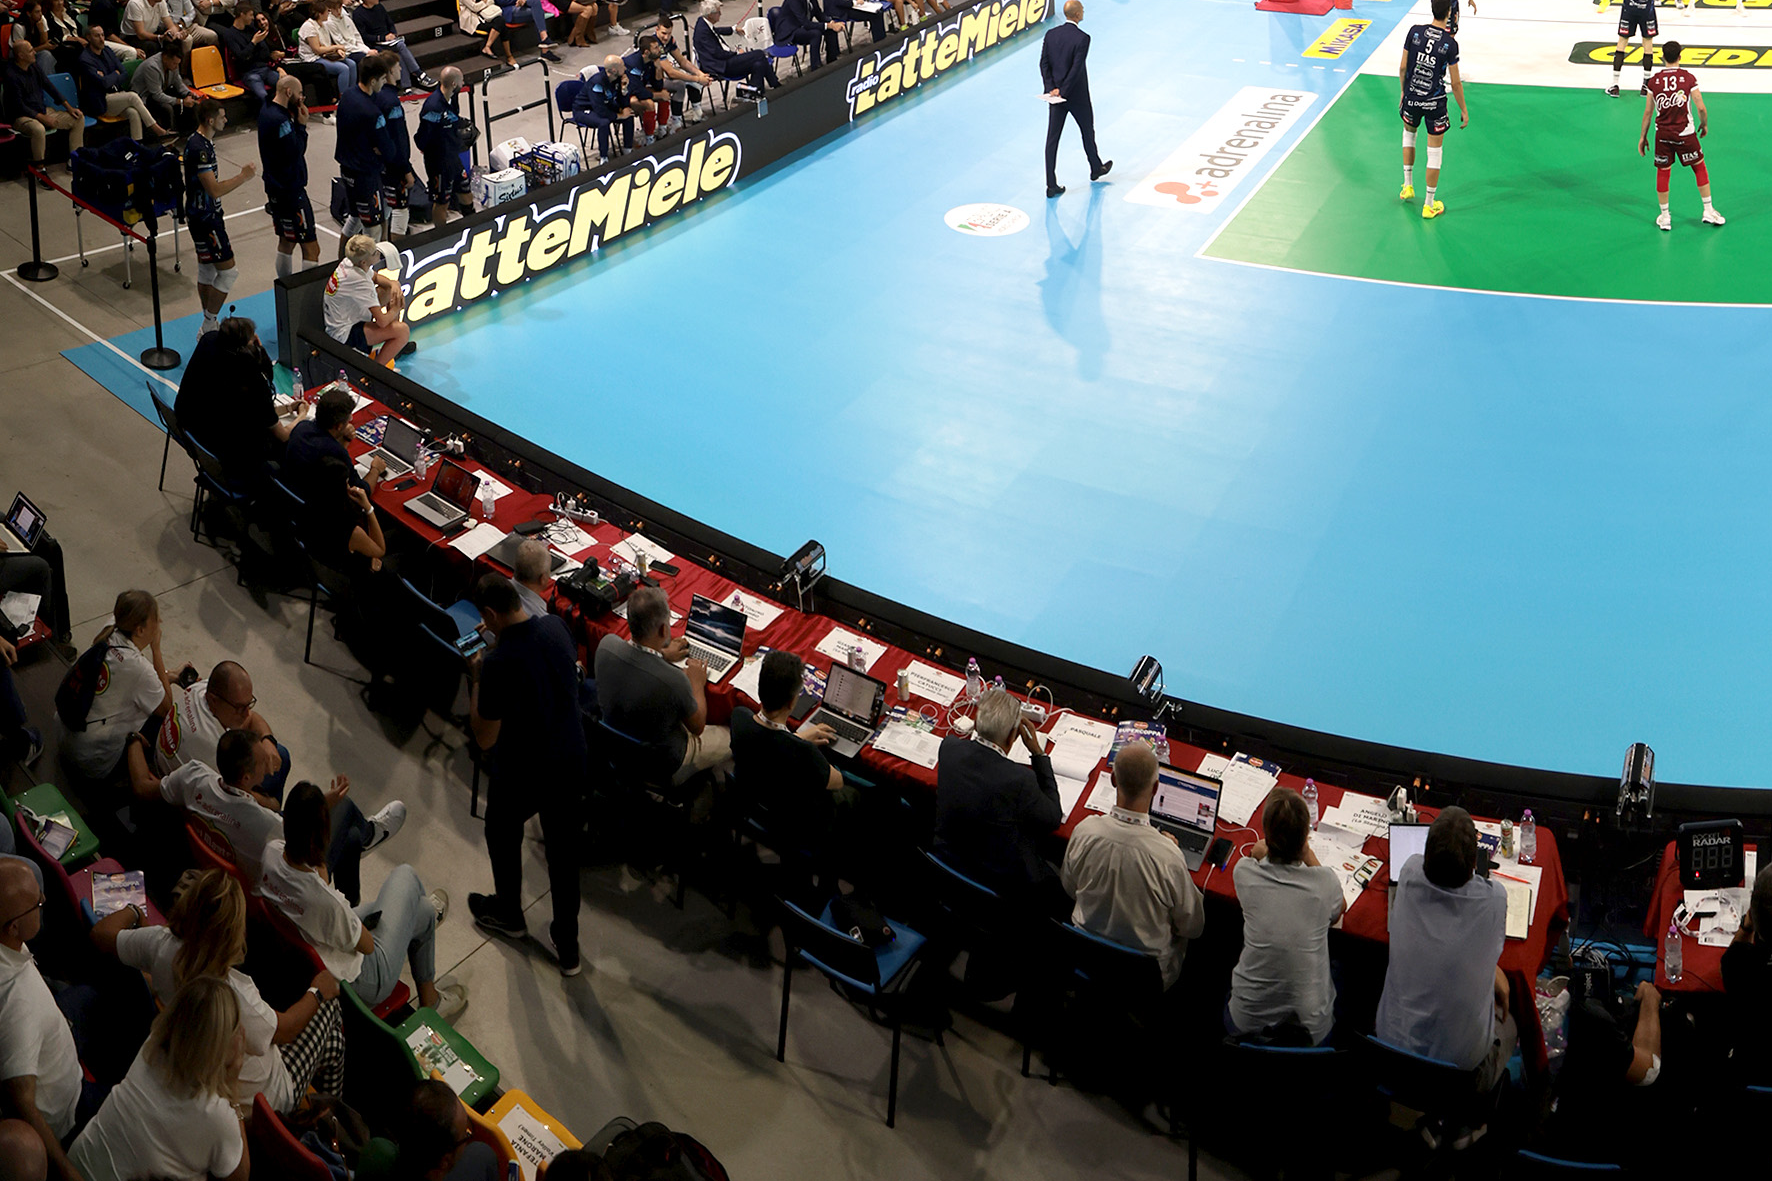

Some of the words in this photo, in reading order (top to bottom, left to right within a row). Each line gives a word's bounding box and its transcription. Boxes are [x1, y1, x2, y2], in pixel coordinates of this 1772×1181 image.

[1319, 22, 1368, 55] MIKASA
[1425, 39, 1436, 54] 5
[1416, 52, 1437, 66] ITAS
[851, 74, 879, 95] radio
[1663, 76, 1677, 91] 13
[1199, 92, 1304, 180] adrenalina
[1682, 151, 1699, 160] ITAS
[498, 183, 524, 205] Sixtus
[910, 671, 956, 692] PIERFRANCESCO
[1069, 726, 1102, 739] PASQUALE
[202, 801, 241, 829] adrenalina
[1360, 808, 1388, 819] ANGELO
[1692, 836, 1732, 847] RADAR
[510, 1139, 539, 1166] TEFANIA
[517, 1135, 547, 1160] MARONE
